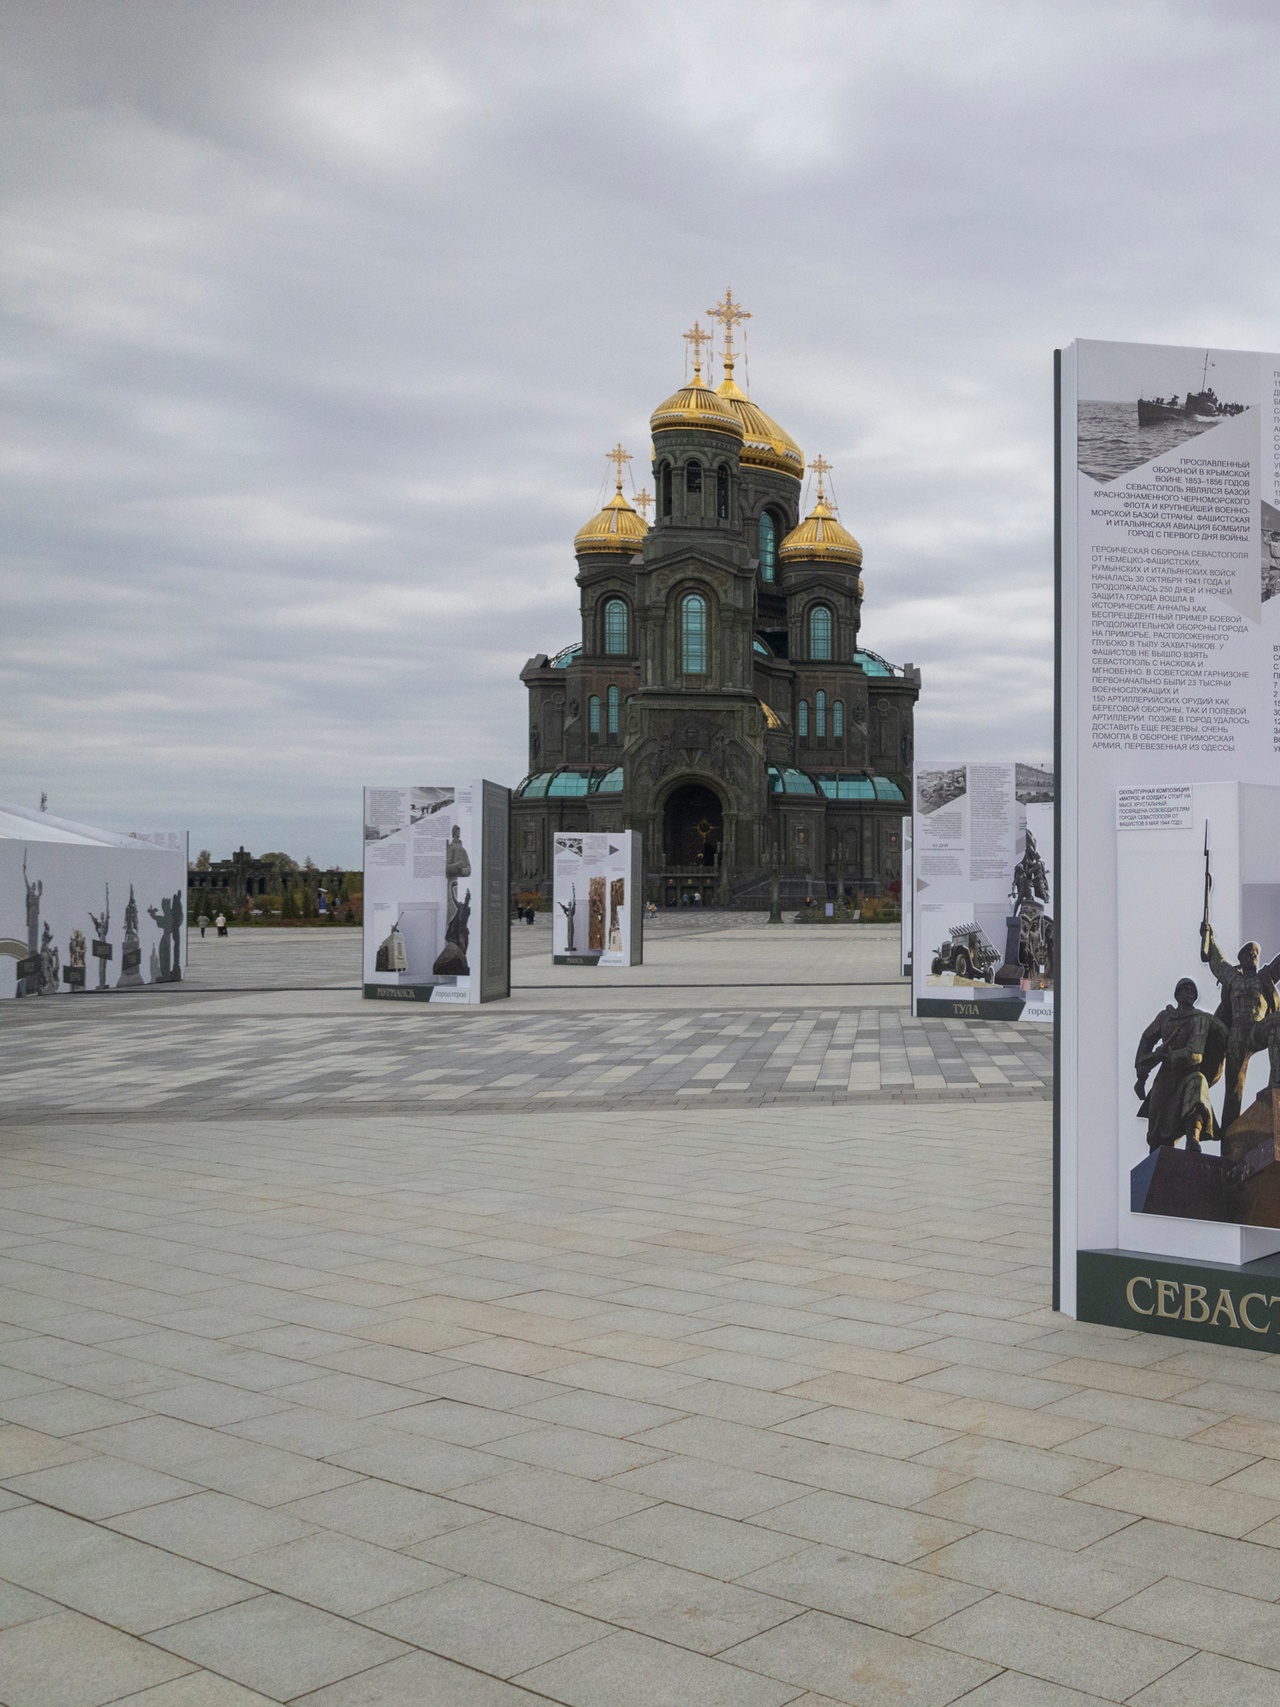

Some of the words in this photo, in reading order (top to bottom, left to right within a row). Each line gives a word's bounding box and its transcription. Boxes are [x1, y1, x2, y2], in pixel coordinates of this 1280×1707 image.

[1180, 458, 1250, 469] ПРОСЛАВЛЕННЫЙ
[1152, 466, 1197, 475] ОБОРОНОЙ
[1206, 469, 1250, 478] КРЫМСКОЙ
[1155, 474, 1182, 483] ВОЙНЕ
[1224, 479, 1250, 488] ГОДОВ
[1126, 483, 1184, 493] СЕВАСТОПОЛЬ
[1186, 486, 1223, 495] ЯВЛЯЛСЯ
[1224, 488, 1250, 496] БАЗОЙ
[1094, 491, 1180, 502] КРАСНОЗНАМЕННОГО
[1181, 495, 1250, 506] ЧЕРНОМОРСКОГО
[1123, 501, 1150, 509] ФЛОТА
[1160, 503, 1213, 512] КРУПНЕЙШЕЙ
[1215, 506, 1250, 514] ВОЕННО-
[1091, 509, 1131, 518] МОРСКОЙ
[1133, 511, 1159, 519] БАЗОЙ
[1197, 514, 1250, 524] ФАШИСТСКАЯ
[1114, 519, 1171, 529] ИТАЛЬЯНСКАЯ
[1173, 522, 1210, 532] АВИАЦИЯ
[1212, 524, 1250, 533] БОМБИЛИ
[1128, 530, 1154, 538] ГОРОД
[1163, 531, 1200, 540] ПЕРВОГО
[1201, 533, 1218, 541] ДНЯ
[952, 1003, 980, 1015] ТУЛА
